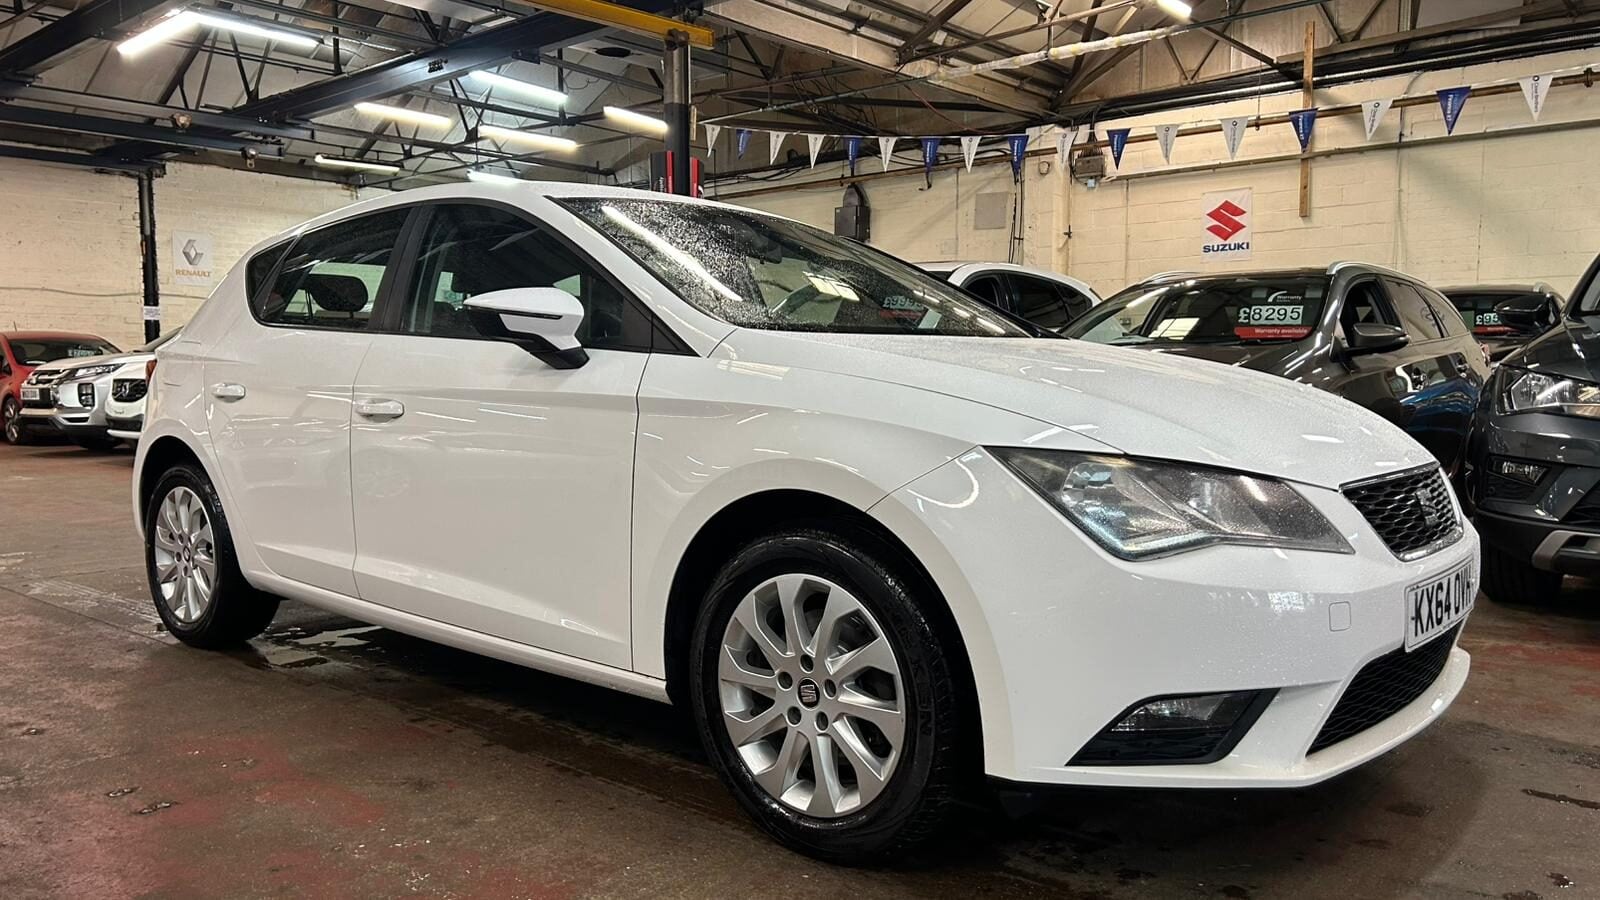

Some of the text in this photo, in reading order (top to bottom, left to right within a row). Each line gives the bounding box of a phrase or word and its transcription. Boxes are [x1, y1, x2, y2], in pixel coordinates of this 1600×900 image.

[1202, 242, 1250, 254] SUZUKI
[175, 269, 211, 278] RENAULT
[1238, 307, 1301, 323] £8295
[1414, 564, 1472, 637] KX64 OVH
